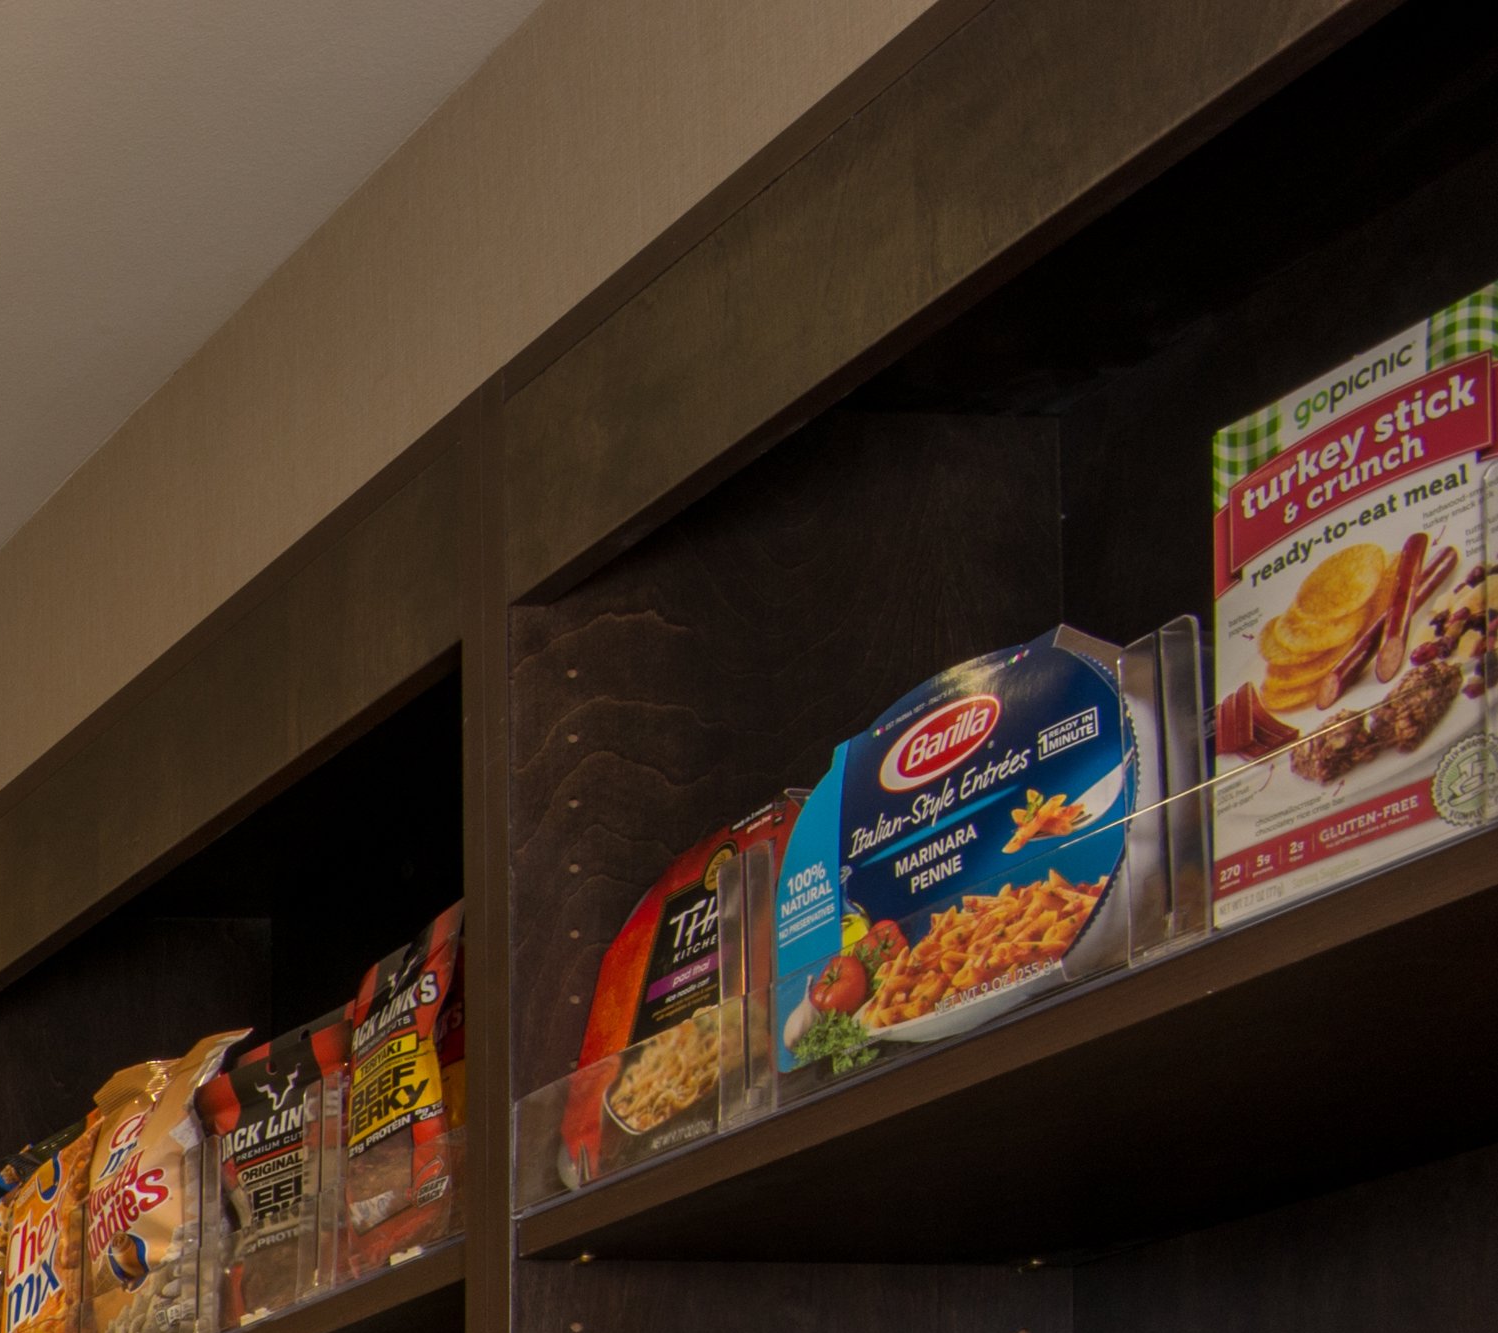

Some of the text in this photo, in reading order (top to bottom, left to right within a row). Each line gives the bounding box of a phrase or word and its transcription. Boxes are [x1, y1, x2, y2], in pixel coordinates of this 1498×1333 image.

[1294, 344, 1413, 429] gopicnic
[1241, 375, 1475, 519] turkey stick
[1283, 434, 1425, 524] & crunch
[1251, 464, 1468, 587] ready-to-eat meal
[904, 705, 991, 772] Barilla
[1038, 723, 1095, 757] 1 MINUTE
[1049, 712, 1094, 739] READY IN
[848, 747, 1031, 858] Italian-Style Entrées
[1319, 795, 1419, 844] GLUTEN-FREE
[895, 824, 978, 879] MARINARA
[787, 861, 827, 897] 100%
[910, 857, 963, 895] PENNE
[1219, 864, 1241, 884] 270
[780, 883, 833, 918] NATURAL
[779, 927, 789, 940] NO
[671, 968, 691, 988] pad
[358, 1040, 404, 1077] TERIYAKI
[352, 1061, 417, 1115] BEEF
[240, 1153, 302, 1183] ORIGINAL
[5, 1203, 59, 1289] Chex
